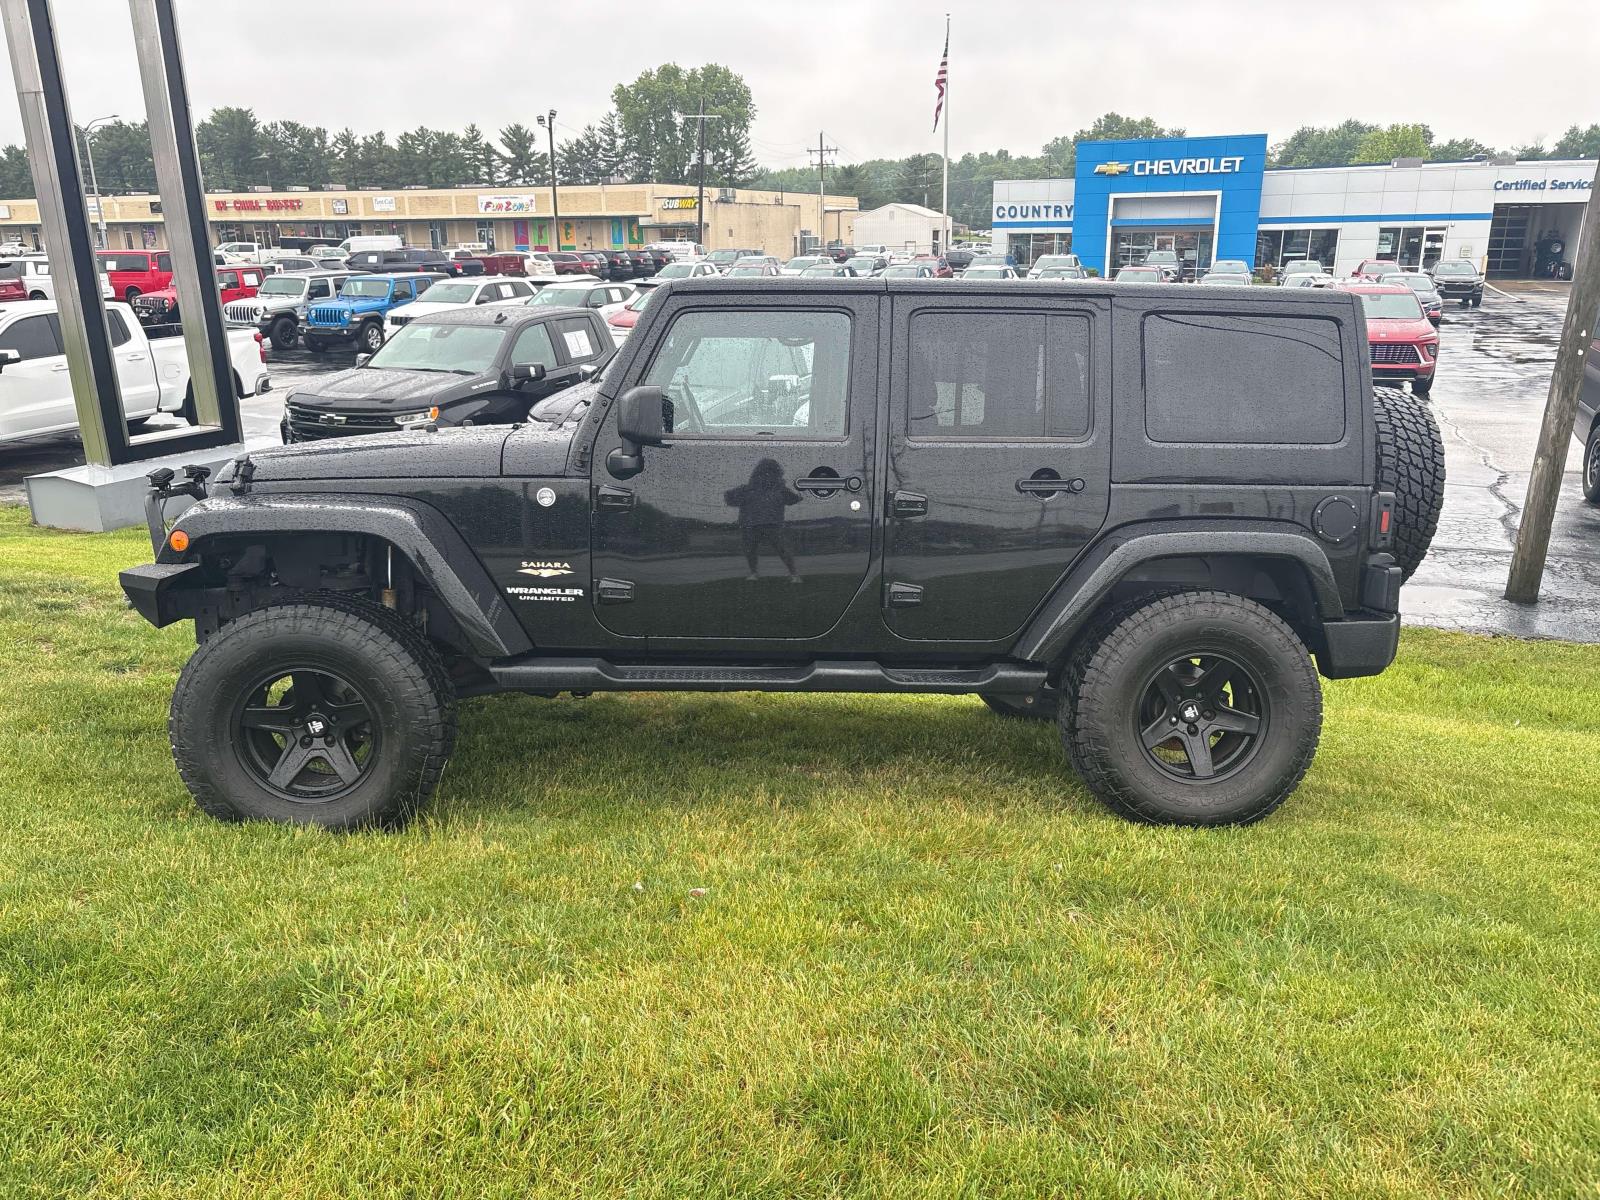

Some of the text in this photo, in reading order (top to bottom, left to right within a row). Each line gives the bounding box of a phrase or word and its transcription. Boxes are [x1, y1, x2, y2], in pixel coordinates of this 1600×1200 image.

[1133, 157, 1244, 176] CHEVROLET
[1493, 179, 1594, 191] Certified Service
[484, 200, 530, 212] Fun Zone
[662, 199, 699, 209] SUBWAY
[996, 204, 1074, 219] COUNTRY
[521, 561, 571, 569] SAHARA
[506, 587, 584, 596] WRANGLER
